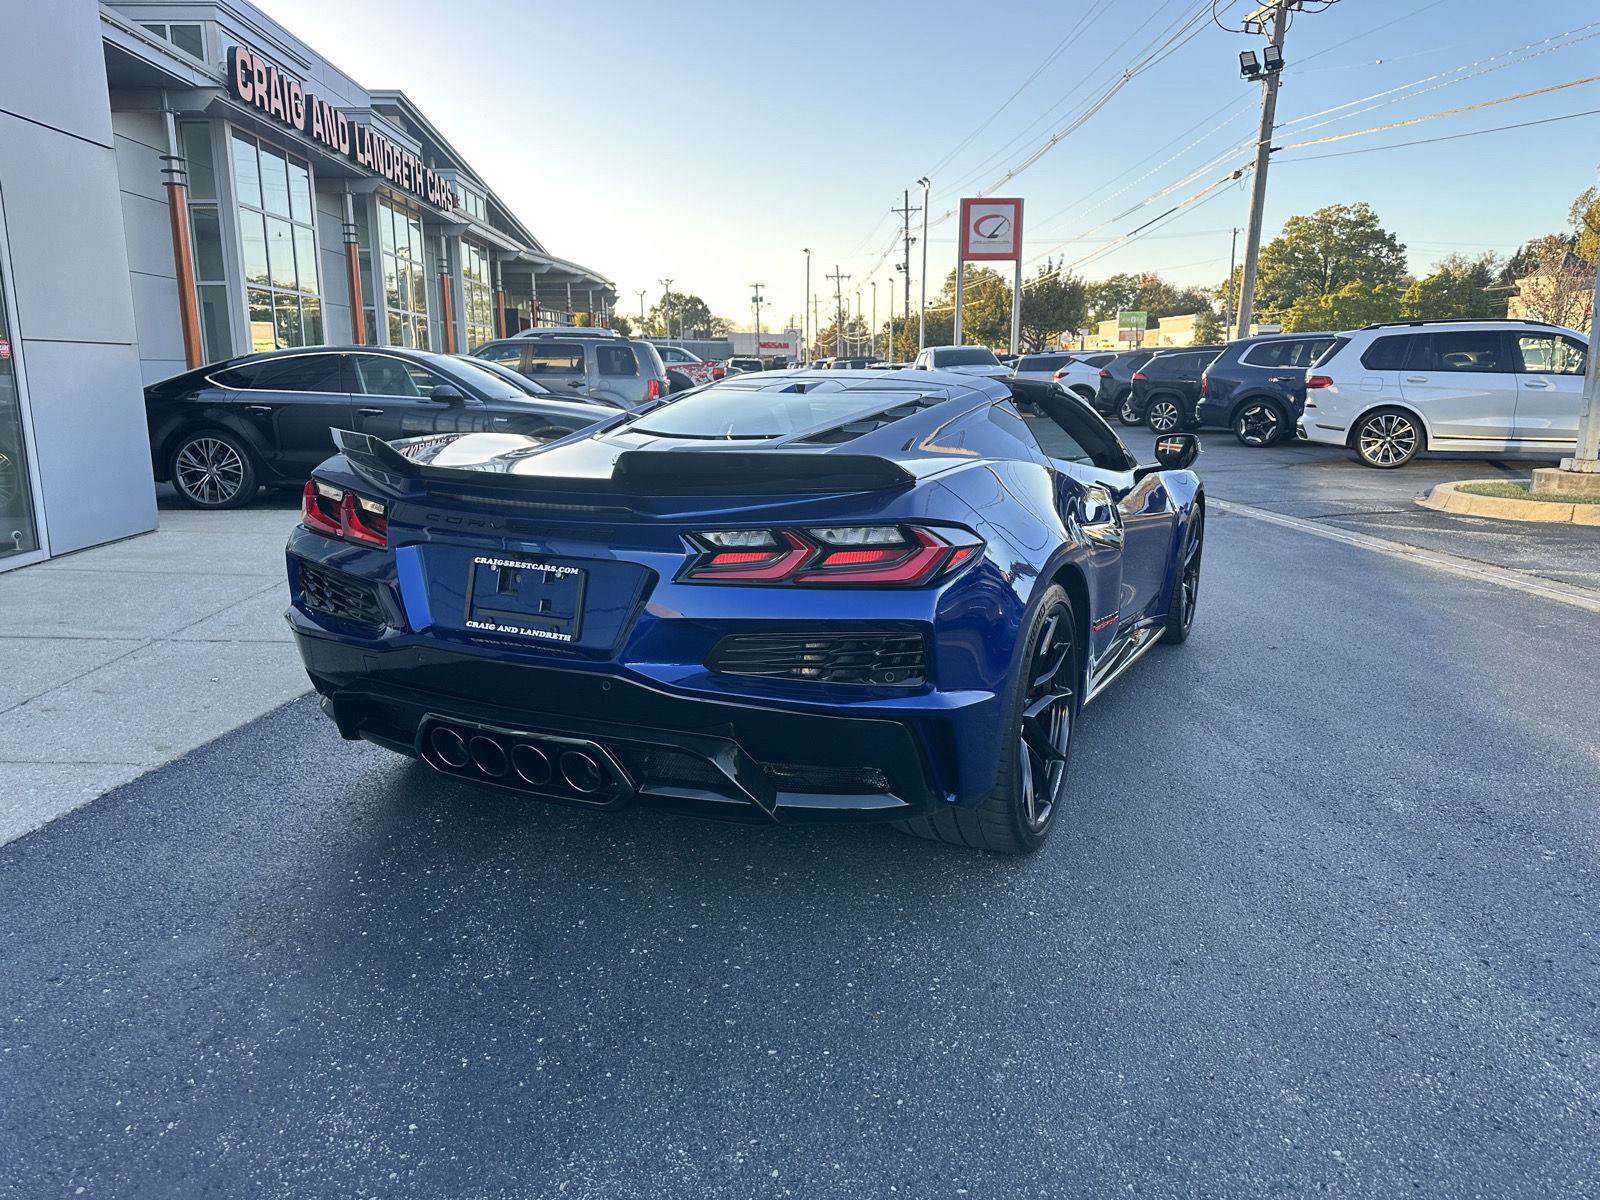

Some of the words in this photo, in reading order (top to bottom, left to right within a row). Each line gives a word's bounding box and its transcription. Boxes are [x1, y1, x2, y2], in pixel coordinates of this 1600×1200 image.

[229, 46, 304, 131] CRAIG
[311, 94, 350, 155] AND
[354, 120, 424, 197] LANDRETH
[426, 167, 454, 212] CARS
[759, 341, 789, 349] NISSAN
[474, 557, 579, 574] CRAIGSBESTCARS.COM
[466, 621, 495, 630] CRAIG
[497, 625, 518, 634] AND
[520, 628, 571, 641] LANDRETH
